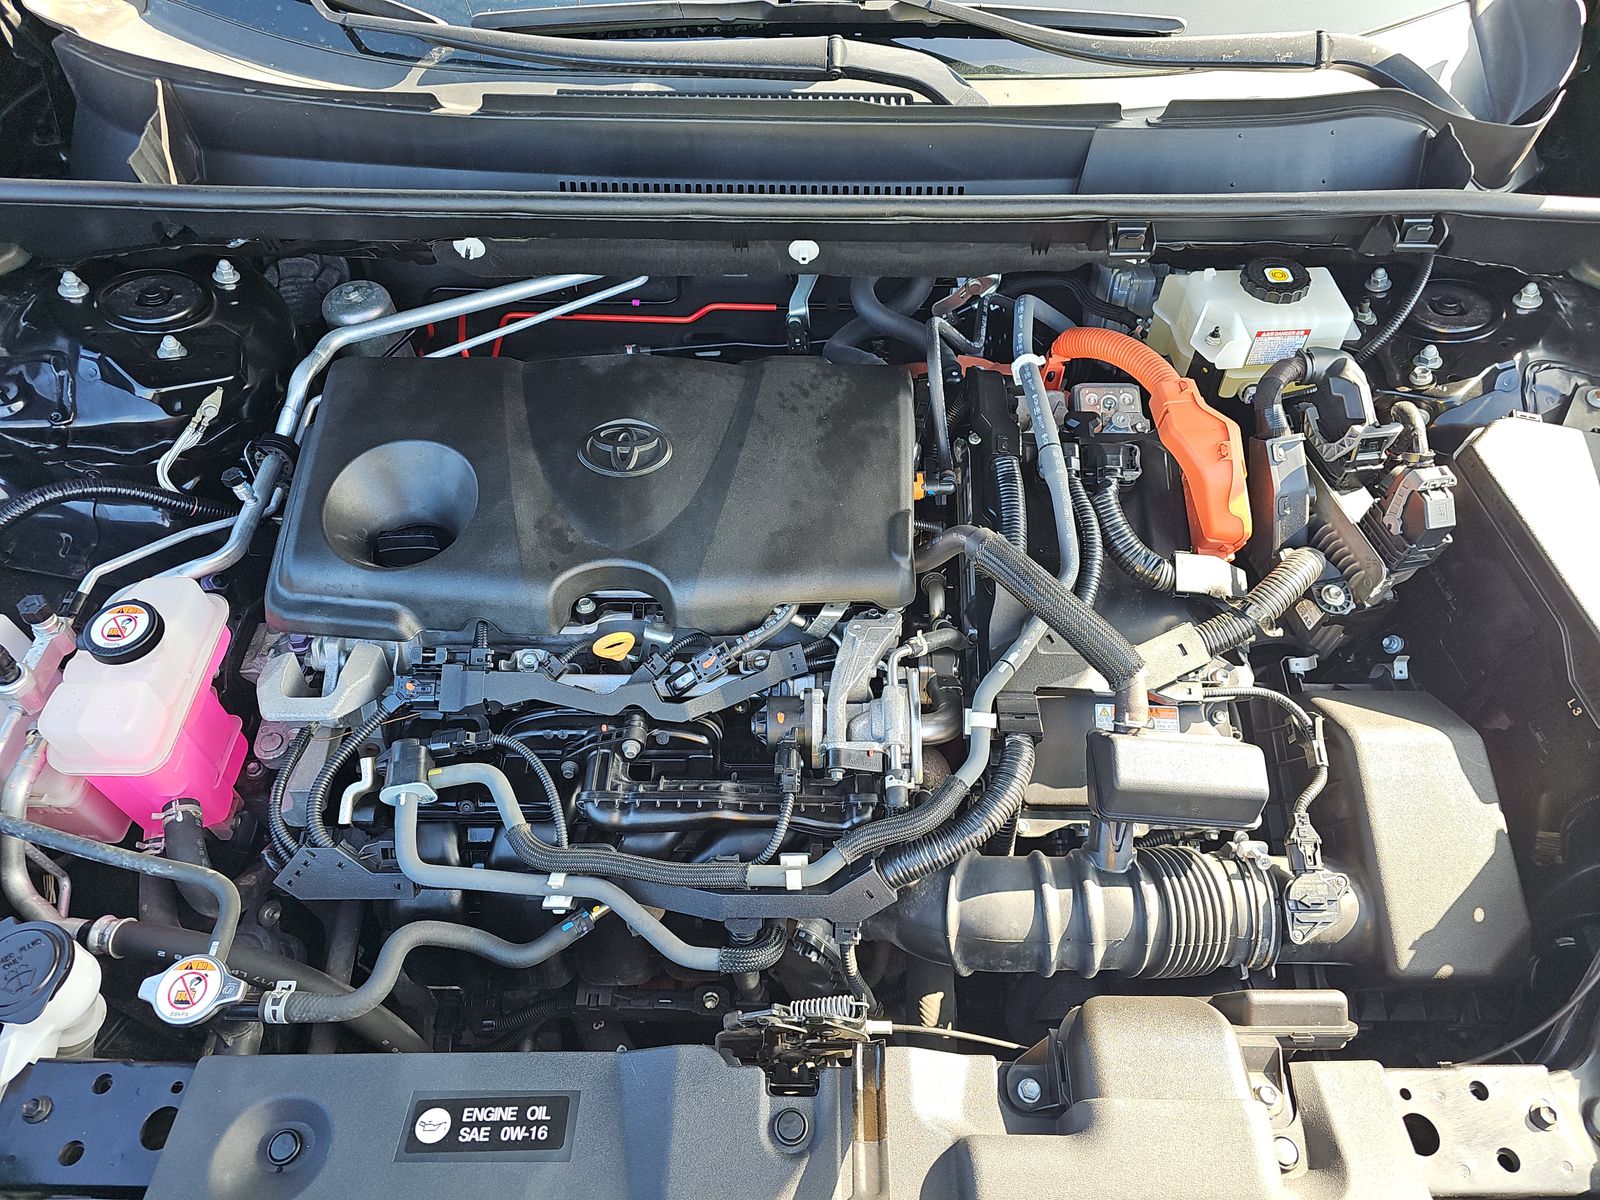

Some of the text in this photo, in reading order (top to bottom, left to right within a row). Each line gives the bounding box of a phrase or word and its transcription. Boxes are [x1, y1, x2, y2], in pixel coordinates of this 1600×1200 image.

[1567, 698, 1582, 716] L3
[461, 1105, 551, 1122] ENGINE OIL
[458, 1125, 548, 1142] SAE 0W-16
